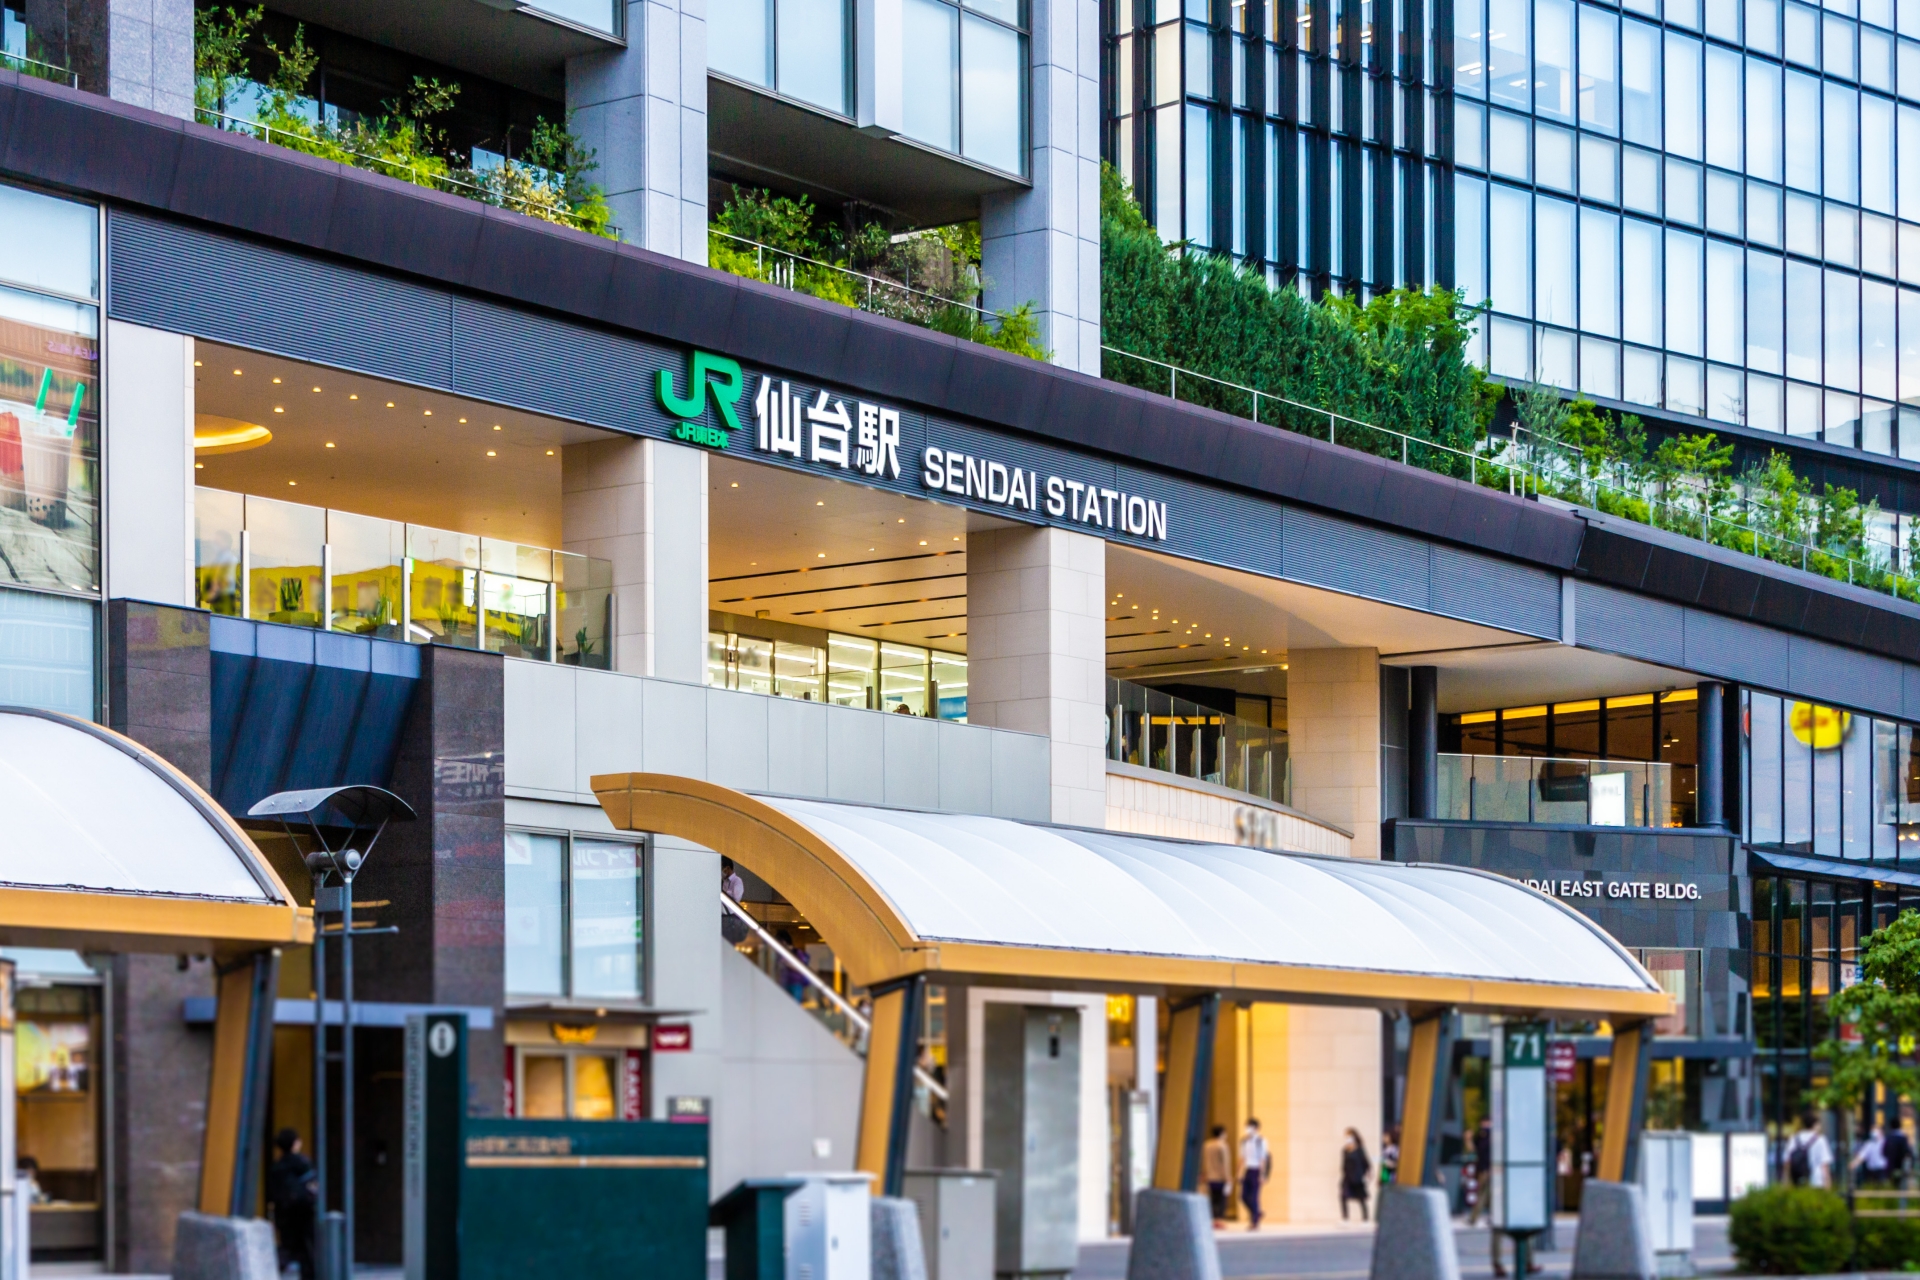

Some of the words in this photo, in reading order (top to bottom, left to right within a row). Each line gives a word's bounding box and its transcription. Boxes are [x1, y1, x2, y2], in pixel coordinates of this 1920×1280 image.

[656, 350, 743, 430] JR
[755, 374, 901, 480] 仙台駅
[923, 447, 1036, 511] SENDAI
[1044, 475, 1167, 541] STATION
[1560, 880, 1603, 897] EAST
[1607, 881, 1650, 899] GATE
[1654, 882, 1702, 900] BLDG.
[1510, 1032, 1541, 1060] 71
